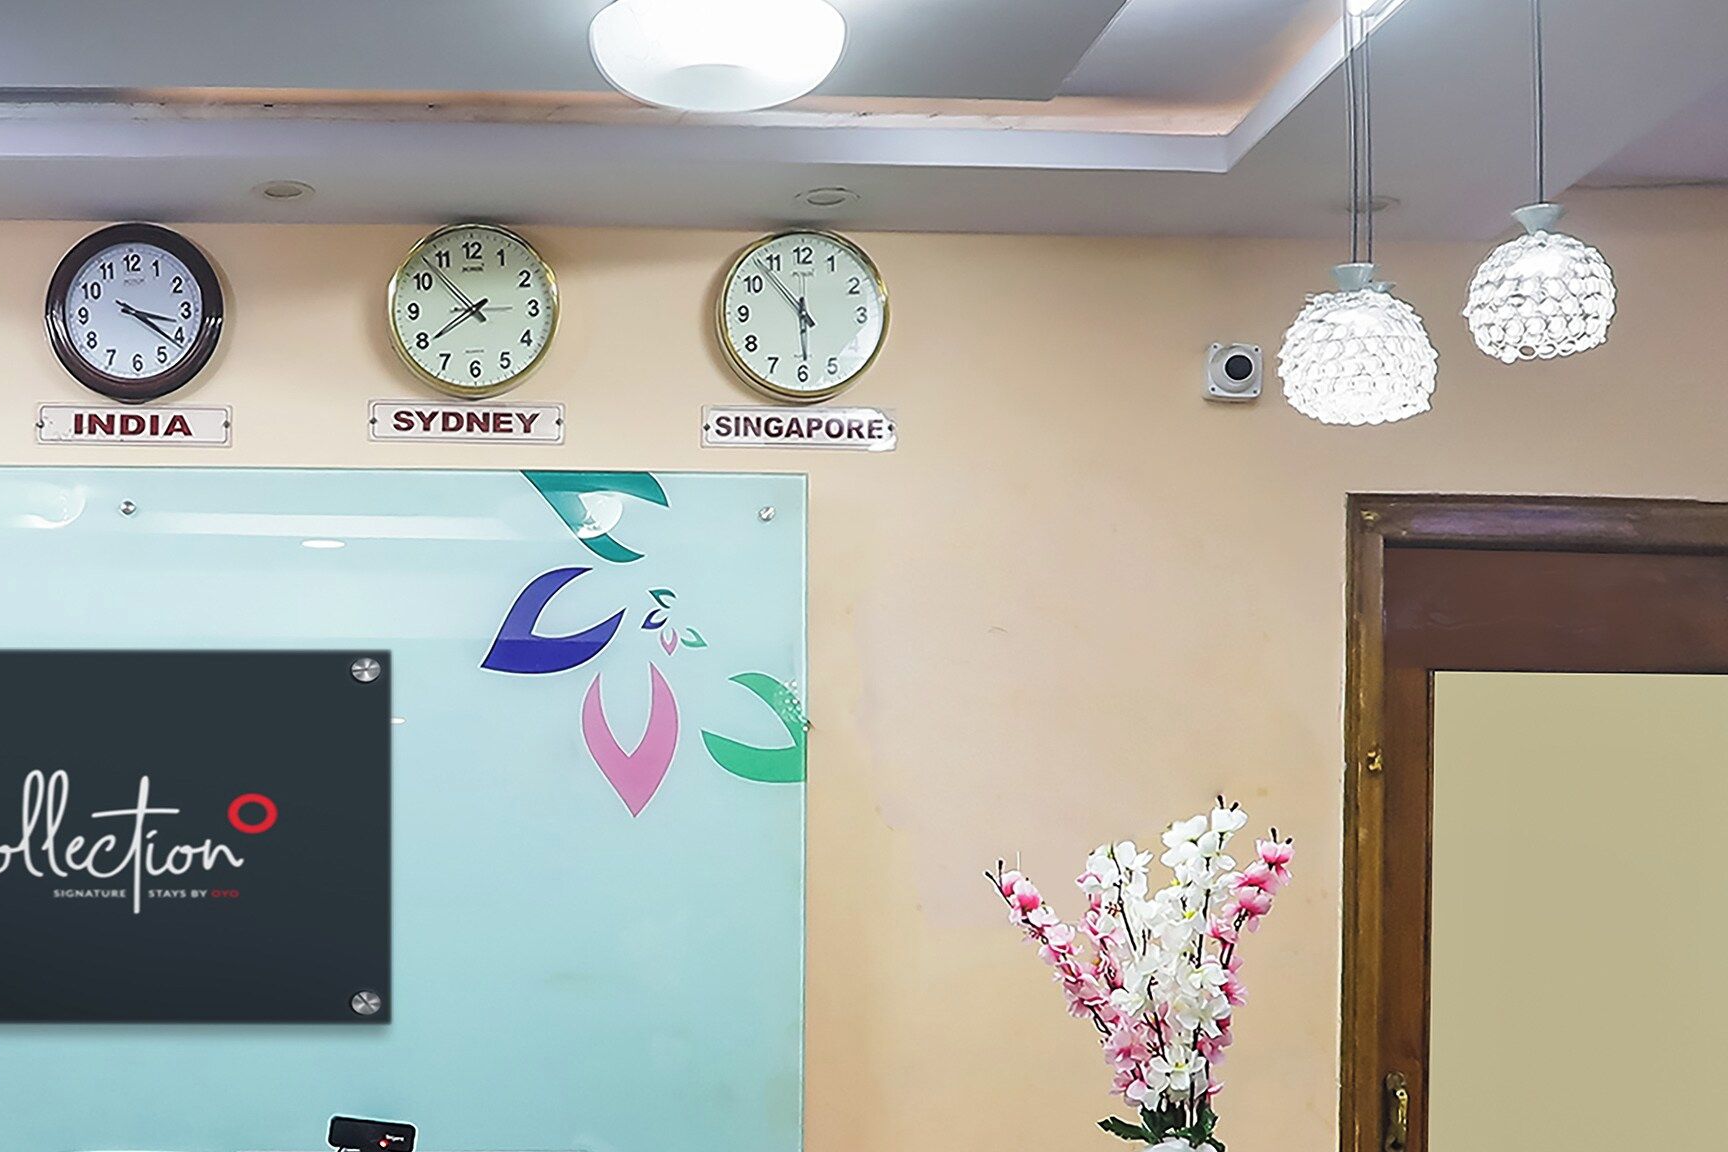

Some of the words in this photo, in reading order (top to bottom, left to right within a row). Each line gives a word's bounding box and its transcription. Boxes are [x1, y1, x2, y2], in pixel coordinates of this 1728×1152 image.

[435, 251, 450, 267] 11
[462, 242, 482, 259] 12
[497, 249, 504, 266] 1
[793, 247, 813, 264] 12
[100, 263, 114, 279] 11
[124, 254, 140, 272] 12
[152, 260, 159, 277] 1
[767, 255, 780, 271] 11
[827, 256, 835, 272] 1
[173, 276, 182, 293] 2
[414, 273, 432, 290] 10
[519, 270, 530, 287] 2
[744, 276, 763, 293] 10
[849, 277, 860, 294] 2
[82, 282, 101, 300] 10
[78, 308, 88, 324] 9
[181, 302, 191, 319] 3
[408, 303, 419, 320] 9
[528, 300, 539, 316] 3
[738, 305, 749, 322] 9
[856, 307, 867, 323] 3
[87, 332, 97, 349] 8
[174, 327, 184, 343] 4
[416, 332, 429, 349] 8
[521, 330, 532, 346] 4
[745, 335, 757, 352] 8
[106, 350, 116, 365] 7
[133, 354, 143, 371] 6
[157, 346, 167, 363] 5
[439, 354, 451, 370] 7
[500, 352, 511, 369] 5
[470, 361, 481, 378] 6
[768, 357, 779, 374] 7
[798, 365, 808, 382] 6
[827, 358, 838, 374] 5
[74, 413, 192, 436] INDIA
[393, 410, 540, 433] SYDNEY
[715, 416, 883, 439] SINGAPORE
[53, 889, 127, 898] SIGNATURE
[148, 889, 187, 898] STAYS
[190, 889, 207, 898] BY
[210, 889, 240, 899] OYO
